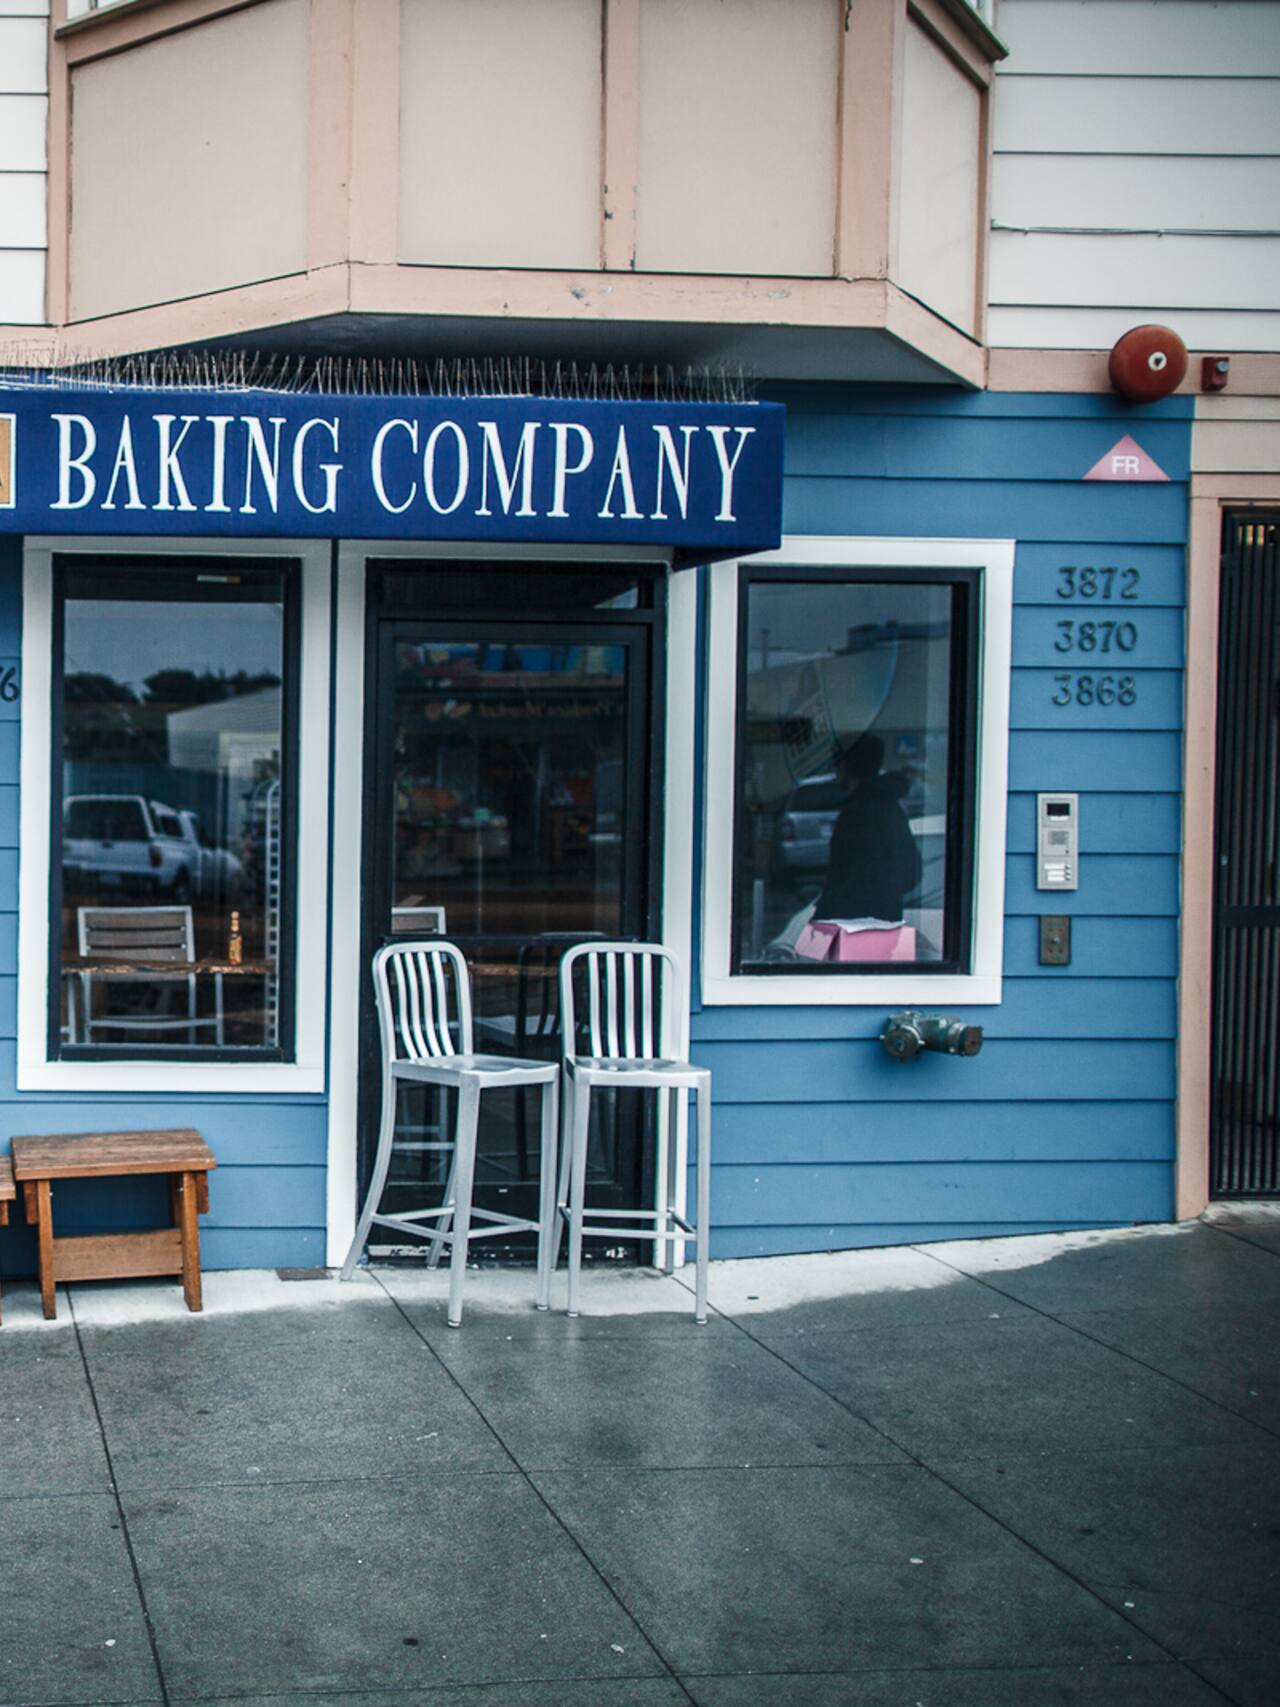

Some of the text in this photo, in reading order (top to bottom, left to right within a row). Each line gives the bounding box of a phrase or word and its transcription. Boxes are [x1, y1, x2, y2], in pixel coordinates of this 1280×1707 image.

[48, 412, 343, 514] BAKING
[371, 417, 758, 522] COMPANY
[1111, 455, 1140, 475] FR
[1056, 566, 1140, 599] 3872
[1054, 620, 1138, 653] 3870
[1051, 674, 1137, 706] 3868
